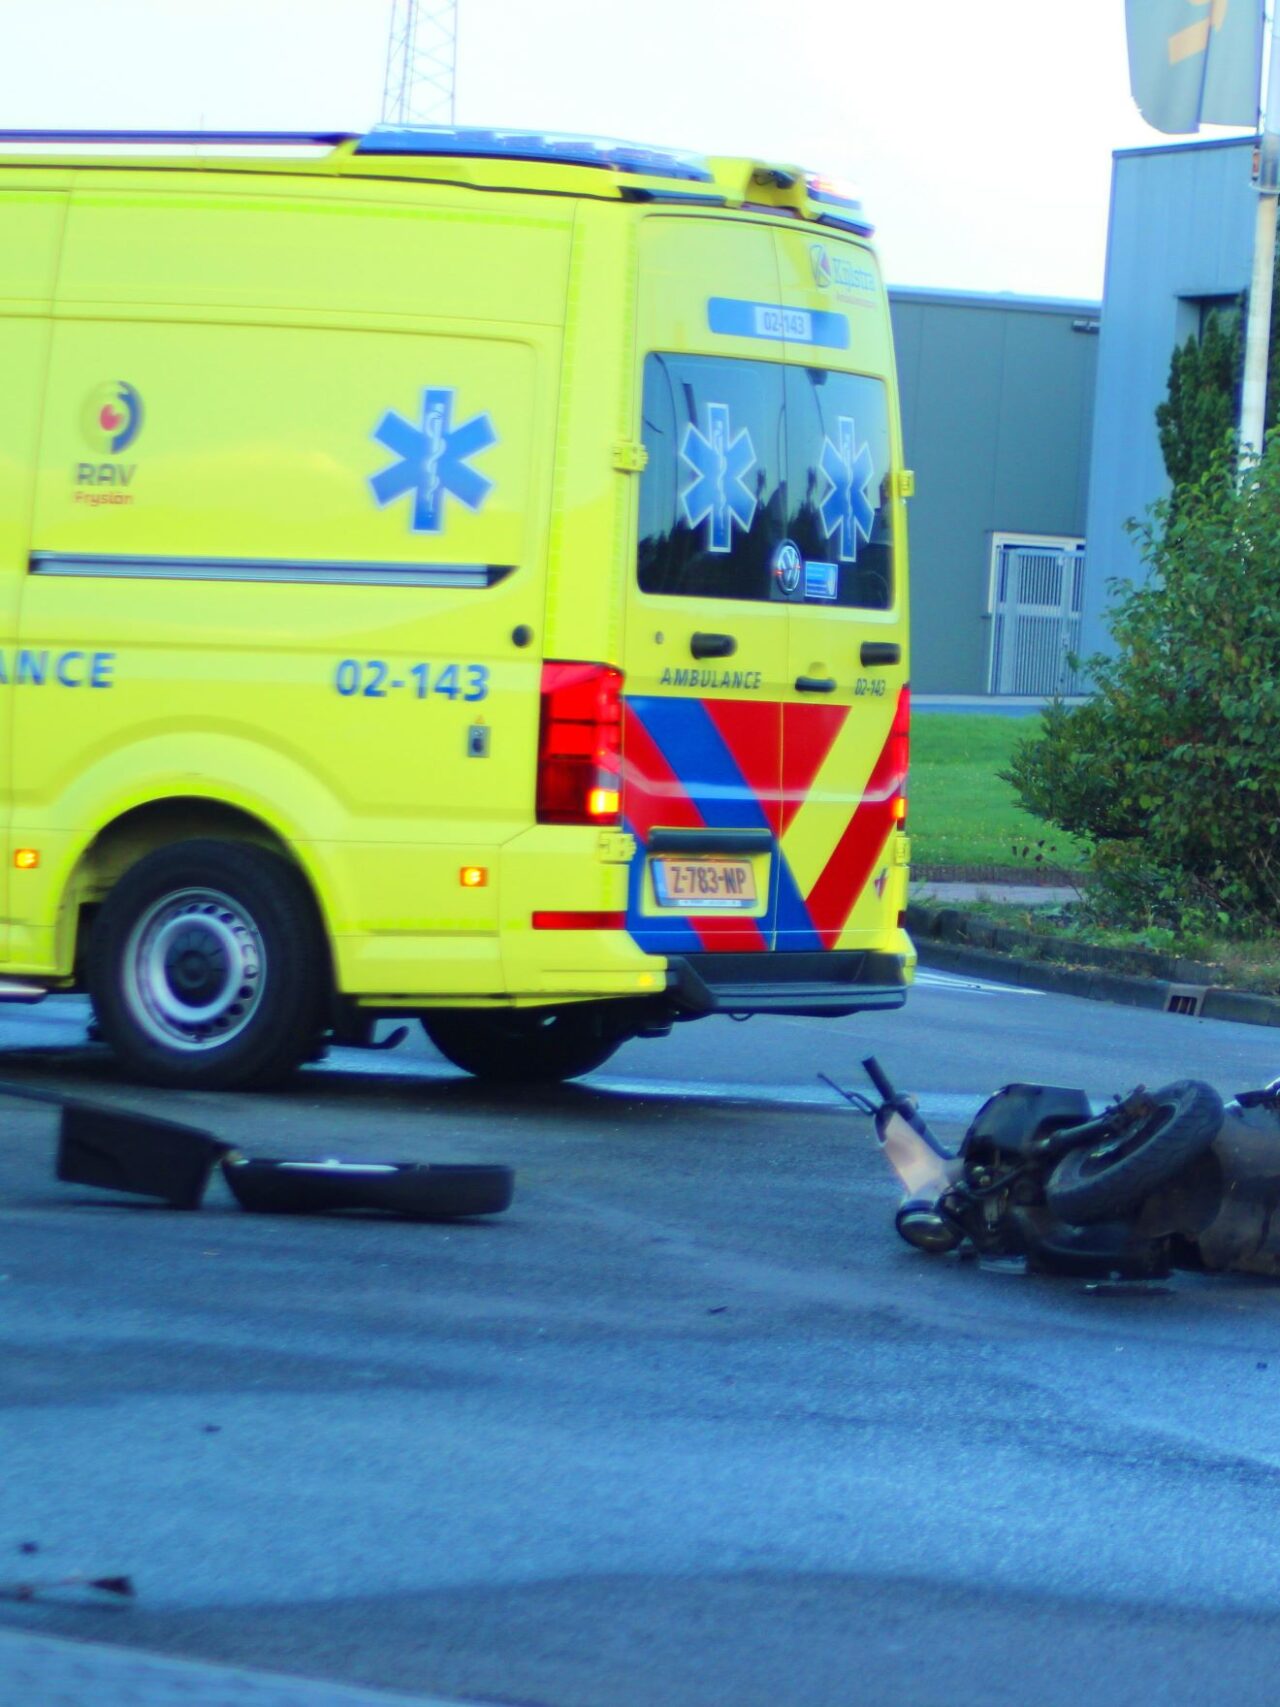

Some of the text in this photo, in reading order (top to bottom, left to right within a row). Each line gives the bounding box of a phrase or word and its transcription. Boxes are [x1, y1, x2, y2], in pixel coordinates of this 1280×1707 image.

[763, 311, 805, 335] 02-143
[76, 462, 138, 487] RAV
[0, 649, 115, 688] NCE
[335, 659, 490, 702] 02-143
[660, 667, 762, 689] AMBULANCE
[854, 677, 886, 696] 02-143
[670, 865, 746, 894] Z-783-NP
